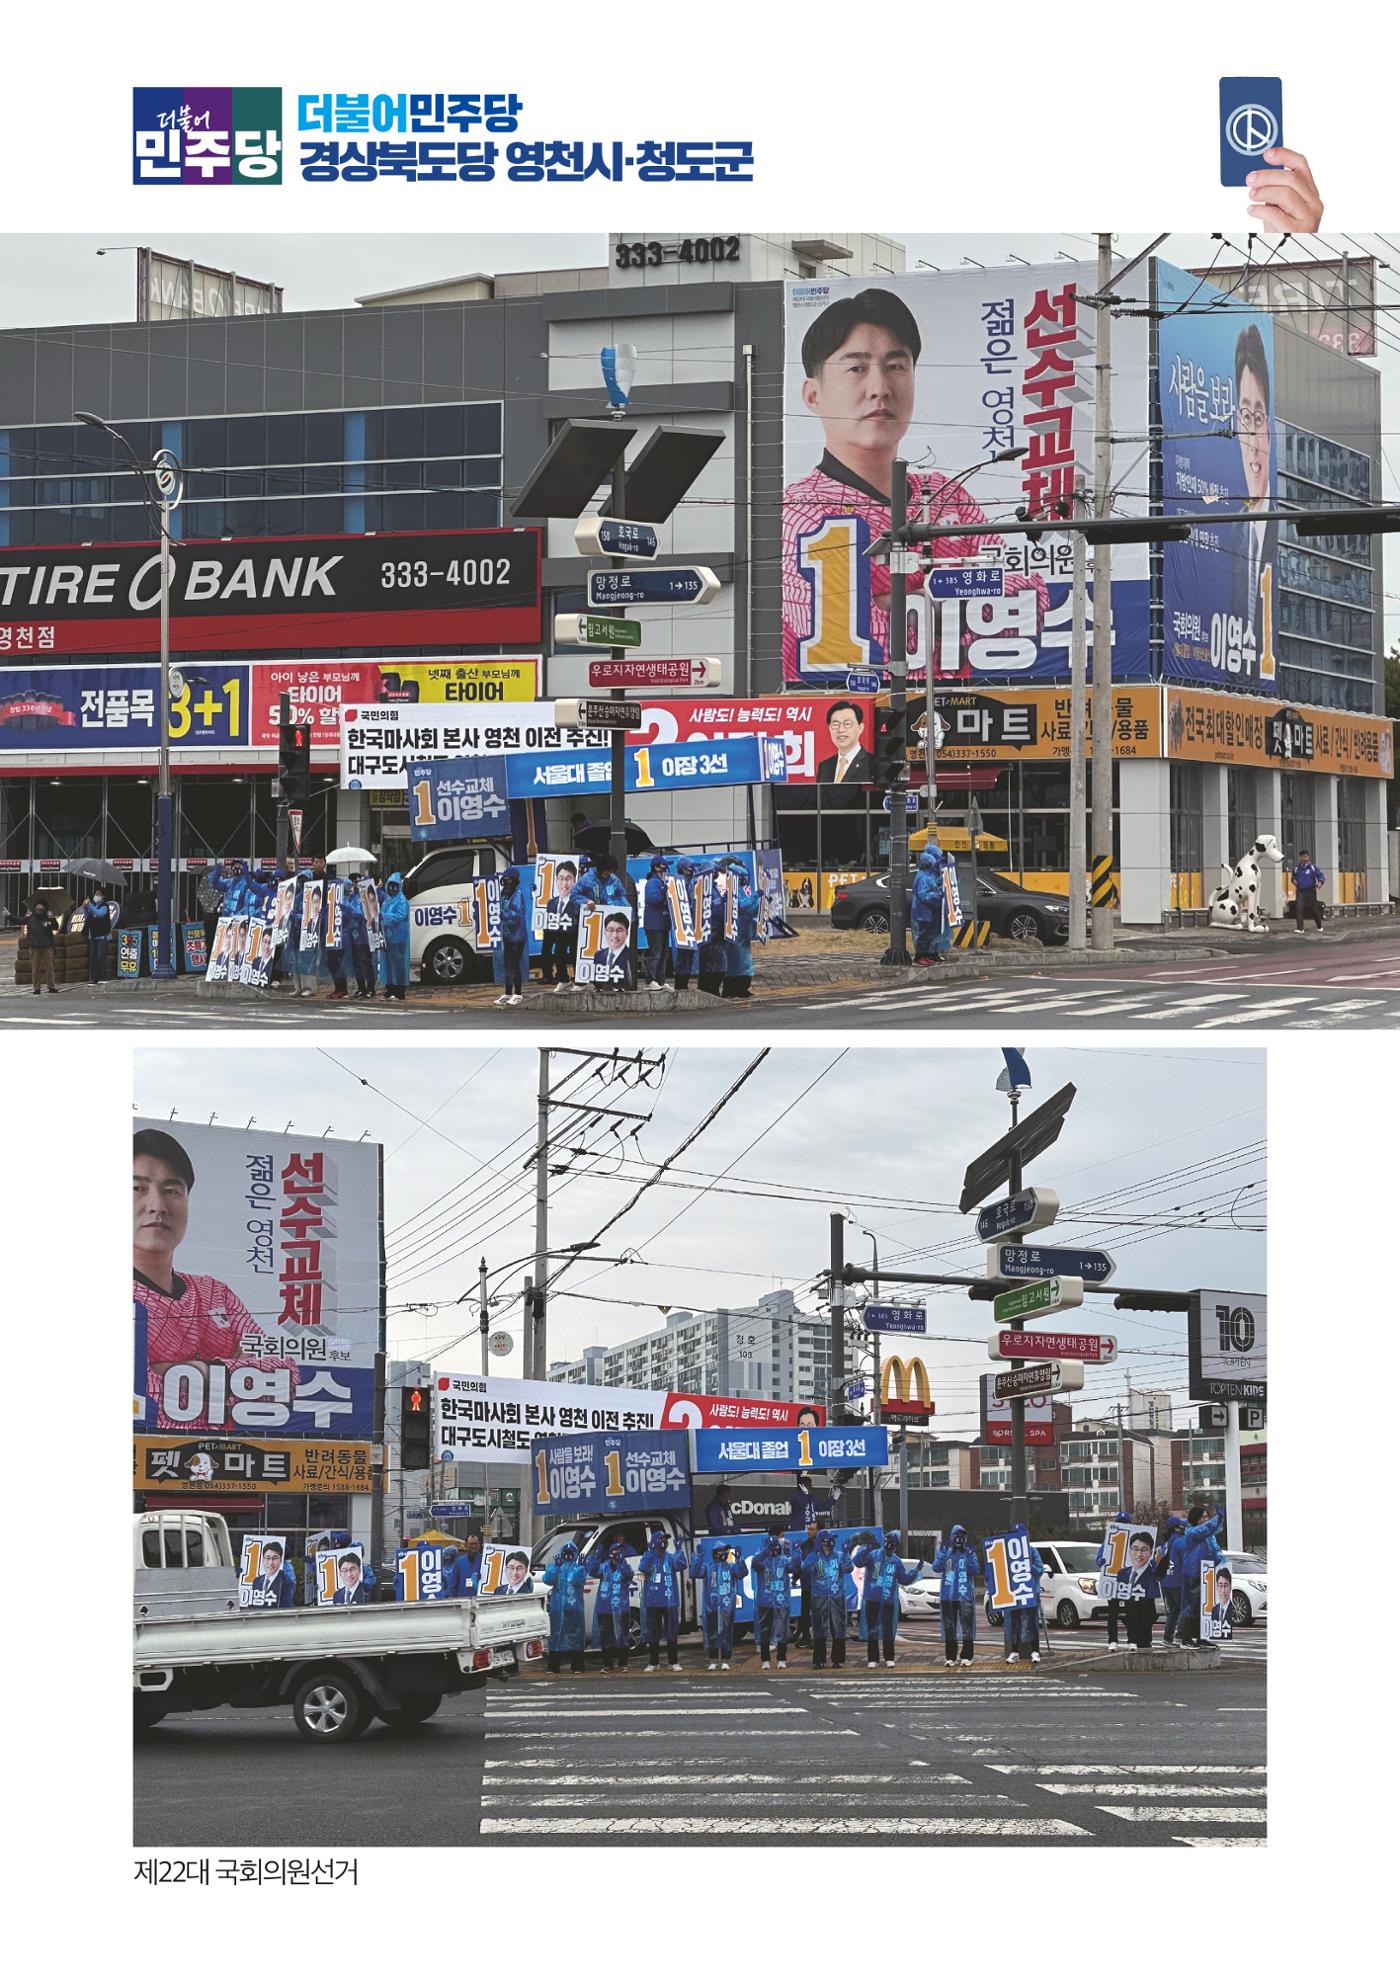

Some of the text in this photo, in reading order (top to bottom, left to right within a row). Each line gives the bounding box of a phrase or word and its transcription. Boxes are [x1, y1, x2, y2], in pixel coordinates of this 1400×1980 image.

[615, 235, 740, 269] 333-4002
[980, 298, 1019, 375] 젊은
[1021, 282, 1078, 521] 선수교체
[1168, 354, 1209, 423] 사람을
[618, 524, 639, 540] 호국로
[0, 556, 510, 606] TIRE BANK 333-4002
[596, 576, 631, 589] 망정로
[962, 570, 1001, 585] 영화로
[596, 591, 644, 601] Mangjeong-ro
[800, 518, 870, 673] 1
[955, 588, 1001, 597] Yeonghwa-ro
[890, 588, 1116, 671] 이영수
[1173, 611, 1201, 642] 국회의원
[1259, 562, 1276, 680] 1
[0, 626, 55, 650] 영천점
[1210, 612, 1257, 676] 이영수
[270, 671, 360, 684] 아이 낳은 부모님께
[428, 668, 520, 681] 넷째 출산 부모님께
[592, 662, 689, 678] 우로지자연생태공원
[287, 685, 342, 703] 타이어
[445, 682, 504, 701] 타이어
[950, 697, 977, 706] MART
[80, 678, 240, 738] 전품목 3+1
[269, 704, 315, 725] 50%
[360, 710, 399, 721] 국민의힘
[689, 707, 813, 723] 사람도! 능력도! 역시
[348, 727, 609, 750] 한국마사회 본사 영천 이전 추진!
[957, 708, 1031, 742] 마트
[1185, 705, 1263, 750] 전국최대할인매장
[1294, 724, 1313, 755] 마트
[909, 748, 997, 760] 영천 054)337-1550
[533, 748, 728, 788] 서울대 1 이장 3선
[436, 777, 495, 797] 선수교체
[413, 780, 437, 826] 1
[437, 794, 507, 821] 이영수
[536, 859, 556, 909] 1
[326, 883, 336, 947] 1
[414, 898, 473, 927] 이영수 1
[474, 879, 492, 947] 1
[534, 911, 572, 930] 이영수
[667, 876, 689, 946] 1
[246, 924, 263, 964] 1
[580, 911, 605, 960] 1
[241, 966, 268, 987] 이영수
[580, 961, 625, 983] 이영수
[245, 1154, 277, 1275] 젊은 영천
[277, 1152, 324, 1327] 선수교체
[1005, 1264, 1055, 1276] Mangjeong-ro
[1006, 1250, 1041, 1263] 망정로
[892, 1310, 924, 1321] 영화로
[1215, 1305, 1256, 1353] 10
[240, 1334, 351, 1361] 국회의원 후보
[740, 1350, 753, 1359] 103
[1001, 1334, 1098, 1352] 우로지자연생태공원
[163, 1363, 353, 1429] 이영수
[453, 1380, 487, 1394] 국민의힘
[441, 1397, 654, 1431] 한국마사회 본사 영천 이전 추진!
[709, 1403, 789, 1422] 사람도! 능력도! 역시
[1251, 1411, 1260, 1425] P
[441, 1426, 531, 1450] 대구도시철도
[1030, 1429, 1046, 1437] SPA
[304, 1448, 367, 1465] 반려동물
[549, 1444, 593, 1464] 사람을 보라!
[625, 1450, 676, 1467] 선수교체
[718, 1430, 866, 1466] 서울대 졸업 1 이장 3선
[151, 1450, 287, 1478] 펫 마트
[535, 1449, 551, 1505] 1
[604, 1450, 625, 1497] 1
[550, 1465, 597, 1499] 이영수
[625, 1467, 686, 1493] 이영수
[731, 1500, 792, 1516] cDonal
[242, 1538, 262, 1586] 1
[1103, 1529, 1130, 1579] 1
[319, 1555, 339, 1602] 1
[399, 1550, 420, 1600] 1
[481, 1549, 505, 1595] 1
[986, 1538, 1017, 1609] 1
[1007, 1535, 1035, 1606] 이영수
[240, 1589, 277, 1607] 이영수
[1102, 1578, 1146, 1601] 이영수
[1203, 1567, 1216, 1616] 1
[1202, 1619, 1232, 1638] 이영수
